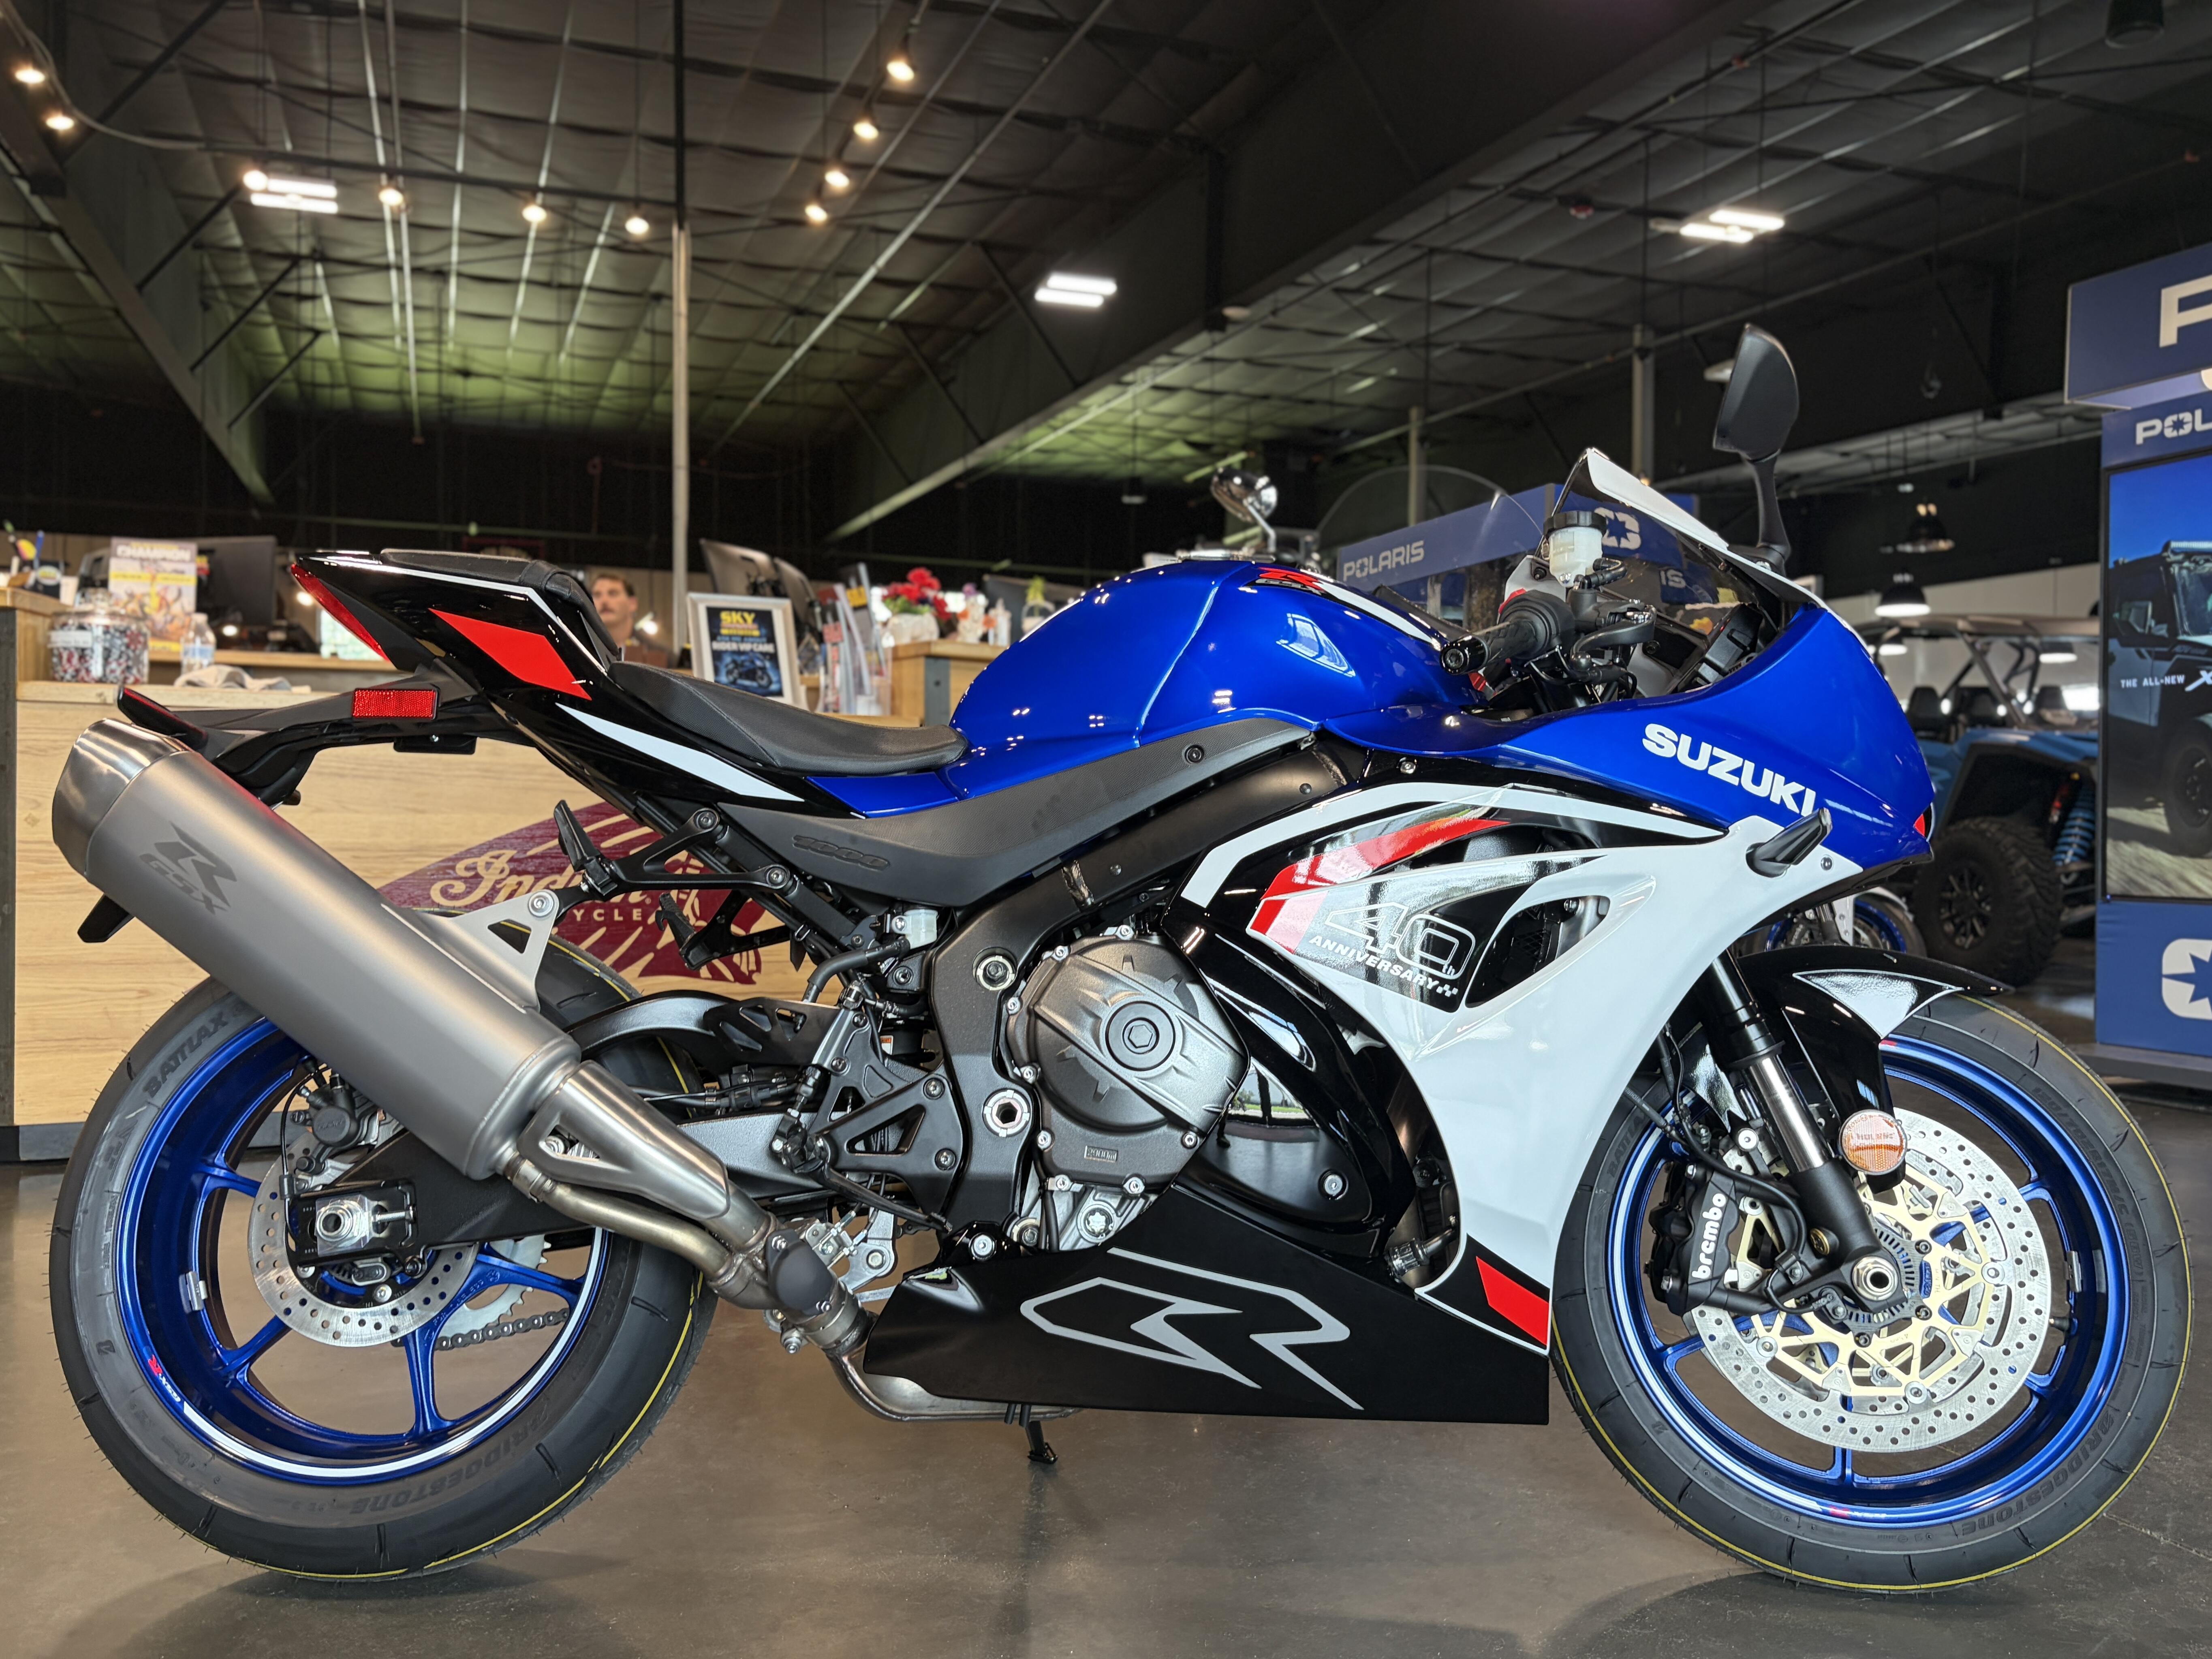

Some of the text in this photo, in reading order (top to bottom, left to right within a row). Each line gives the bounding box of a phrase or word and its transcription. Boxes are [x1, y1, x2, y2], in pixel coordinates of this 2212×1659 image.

[1343, 540, 1424, 582] POLARIS
[720, 611, 755, 624] SKY
[2120, 678, 2137, 688] THE
[1642, 723, 1816, 817] SUZUKI
[1308, 935, 1439, 990] ANNIVERSARY
[143, 1011, 229, 1098] BATTLAX
[1692, 1193, 1727, 1279] brembo
[349, 1395, 548, 1515] BRIDGESTONE
[1962, 1413, 2114, 1536] BRIDGESTONE
